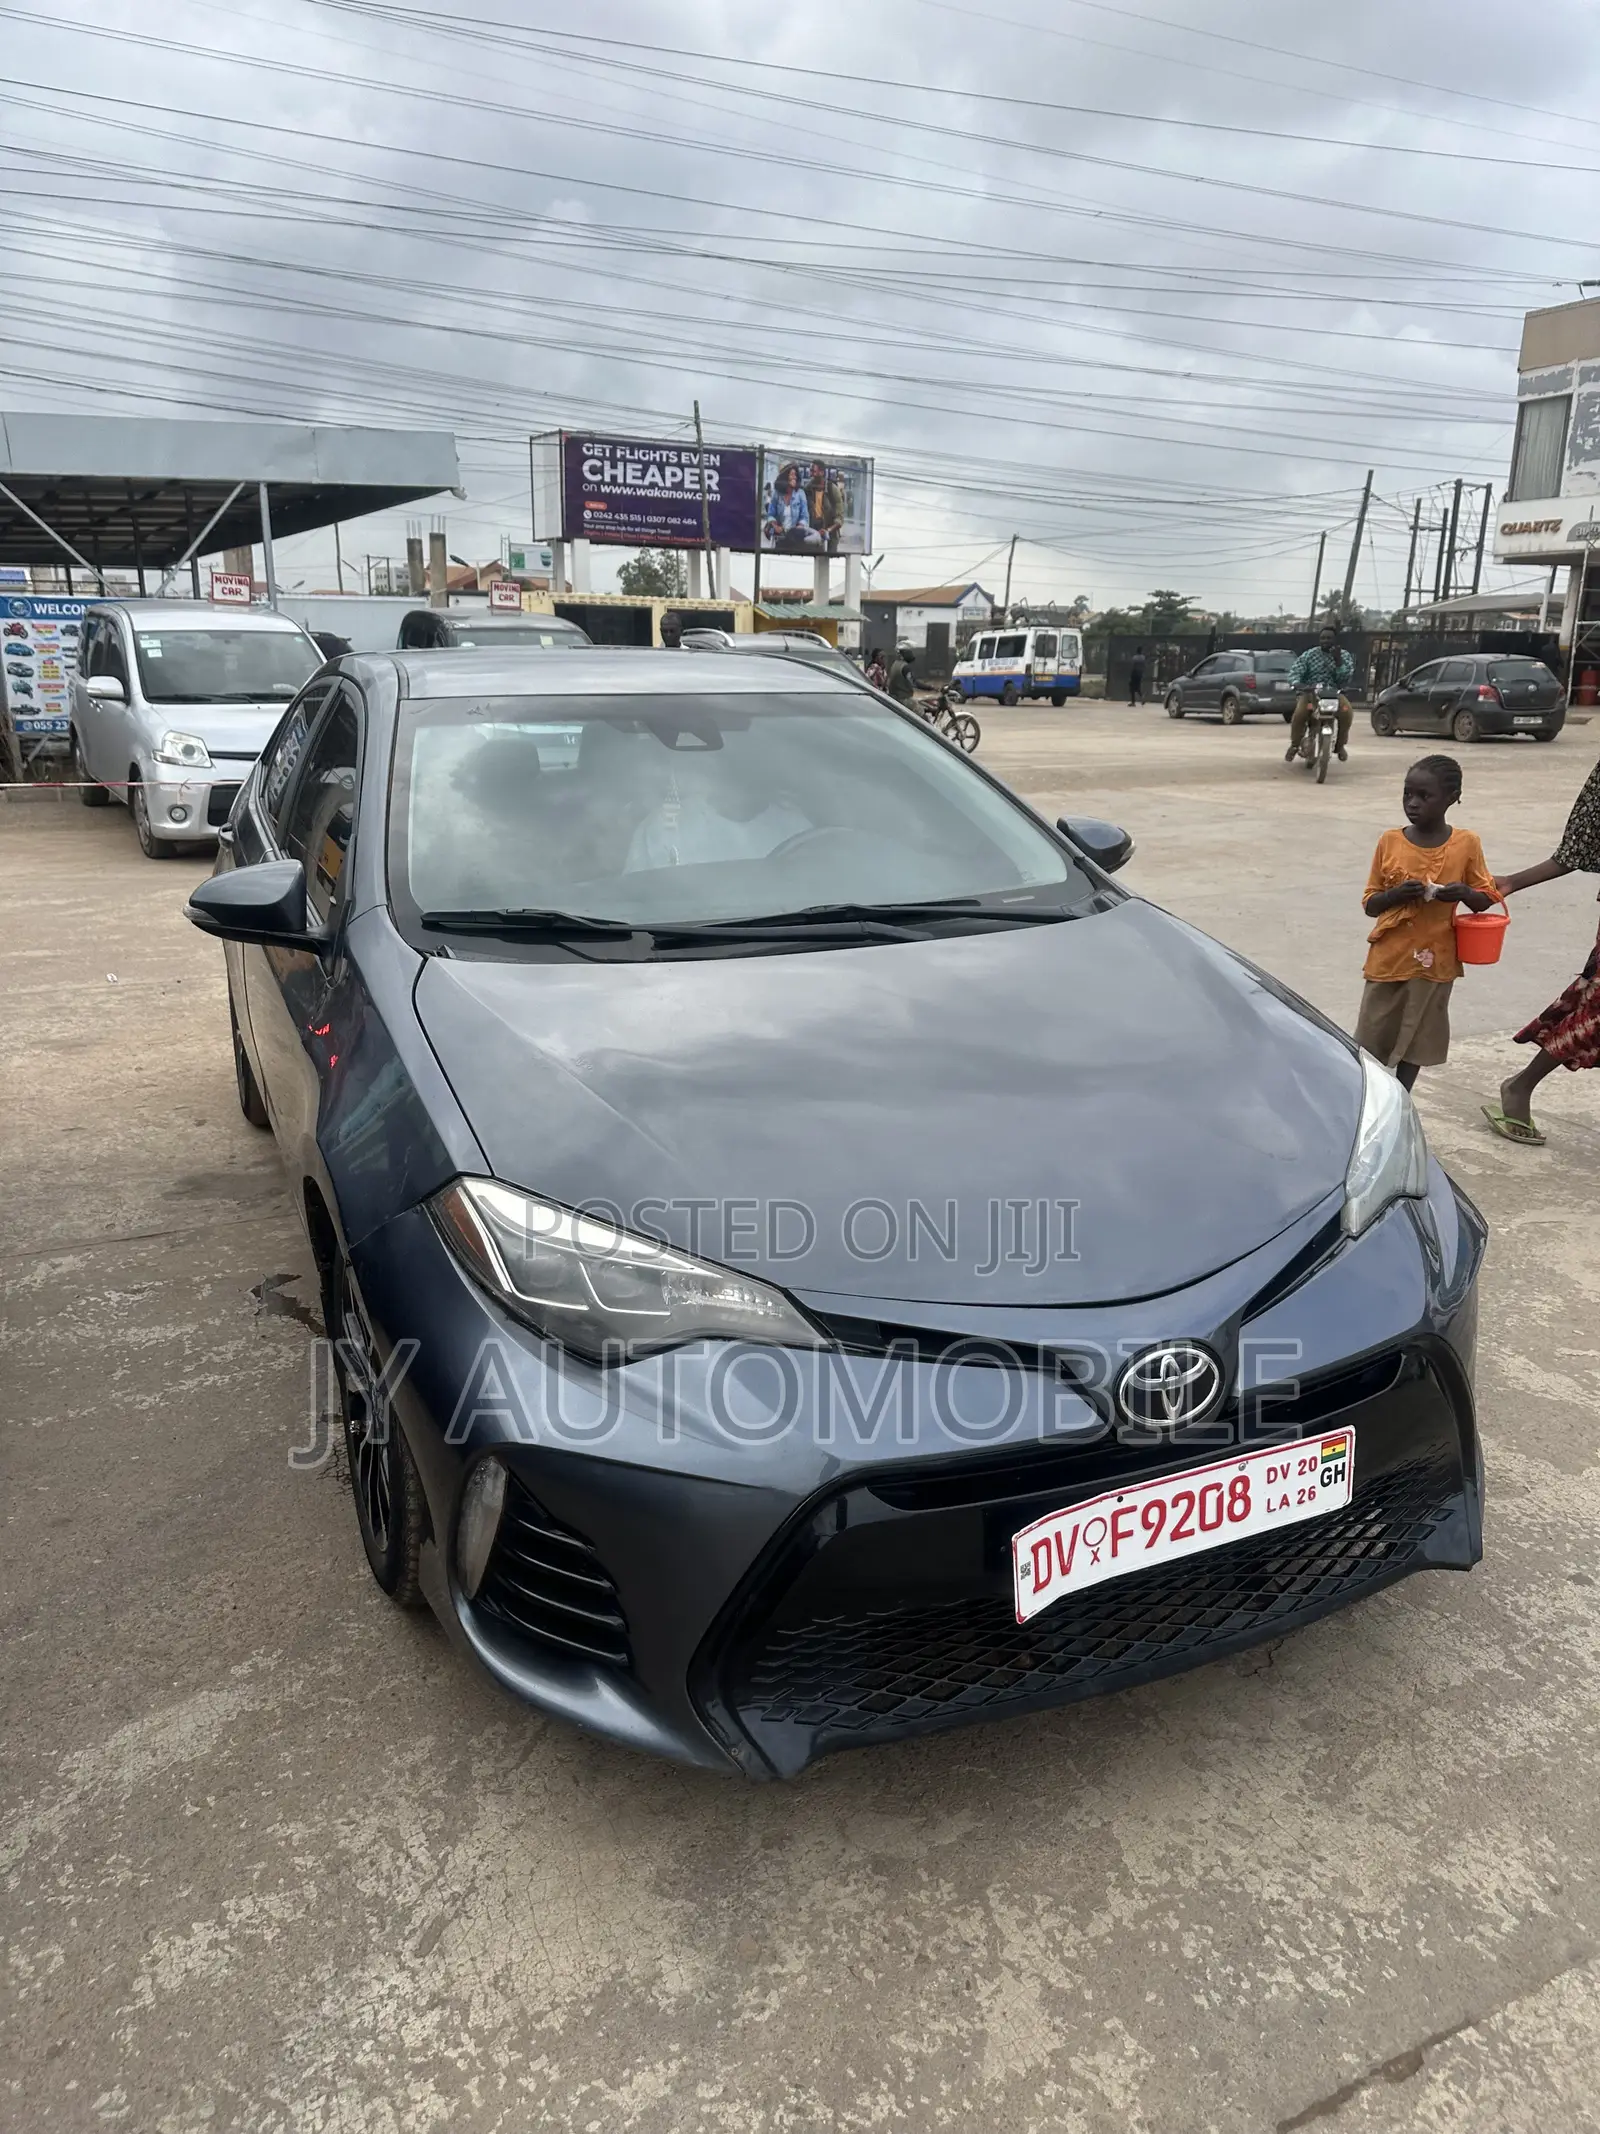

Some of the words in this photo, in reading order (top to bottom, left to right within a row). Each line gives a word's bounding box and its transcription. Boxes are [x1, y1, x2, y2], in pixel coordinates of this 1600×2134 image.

[582, 442, 612, 457] GET
[616, 445, 678, 463] FLIGHTS
[681, 451, 720, 467] EVEN
[582, 458, 720, 491] CHEAPER
[582, 483, 597, 492] on
[1501, 518, 1563, 536] QUARTZ
[215, 575, 249, 587] MOVING
[493, 583, 520, 592] MOVING
[221, 586, 244, 596] CAR
[499, 594, 515, 602] CAR
[33, 721, 52, 730] 055
[1266, 1463, 1291, 1485] DV
[1297, 1455, 1319, 1475] 20
[1320, 1462, 1346, 1489] GH
[1266, 1496, 1290, 1514] LA
[1297, 1485, 1317, 1506] 26
[1030, 1523, 1080, 1594] DV
[1110, 1474, 1252, 1558] F9208
